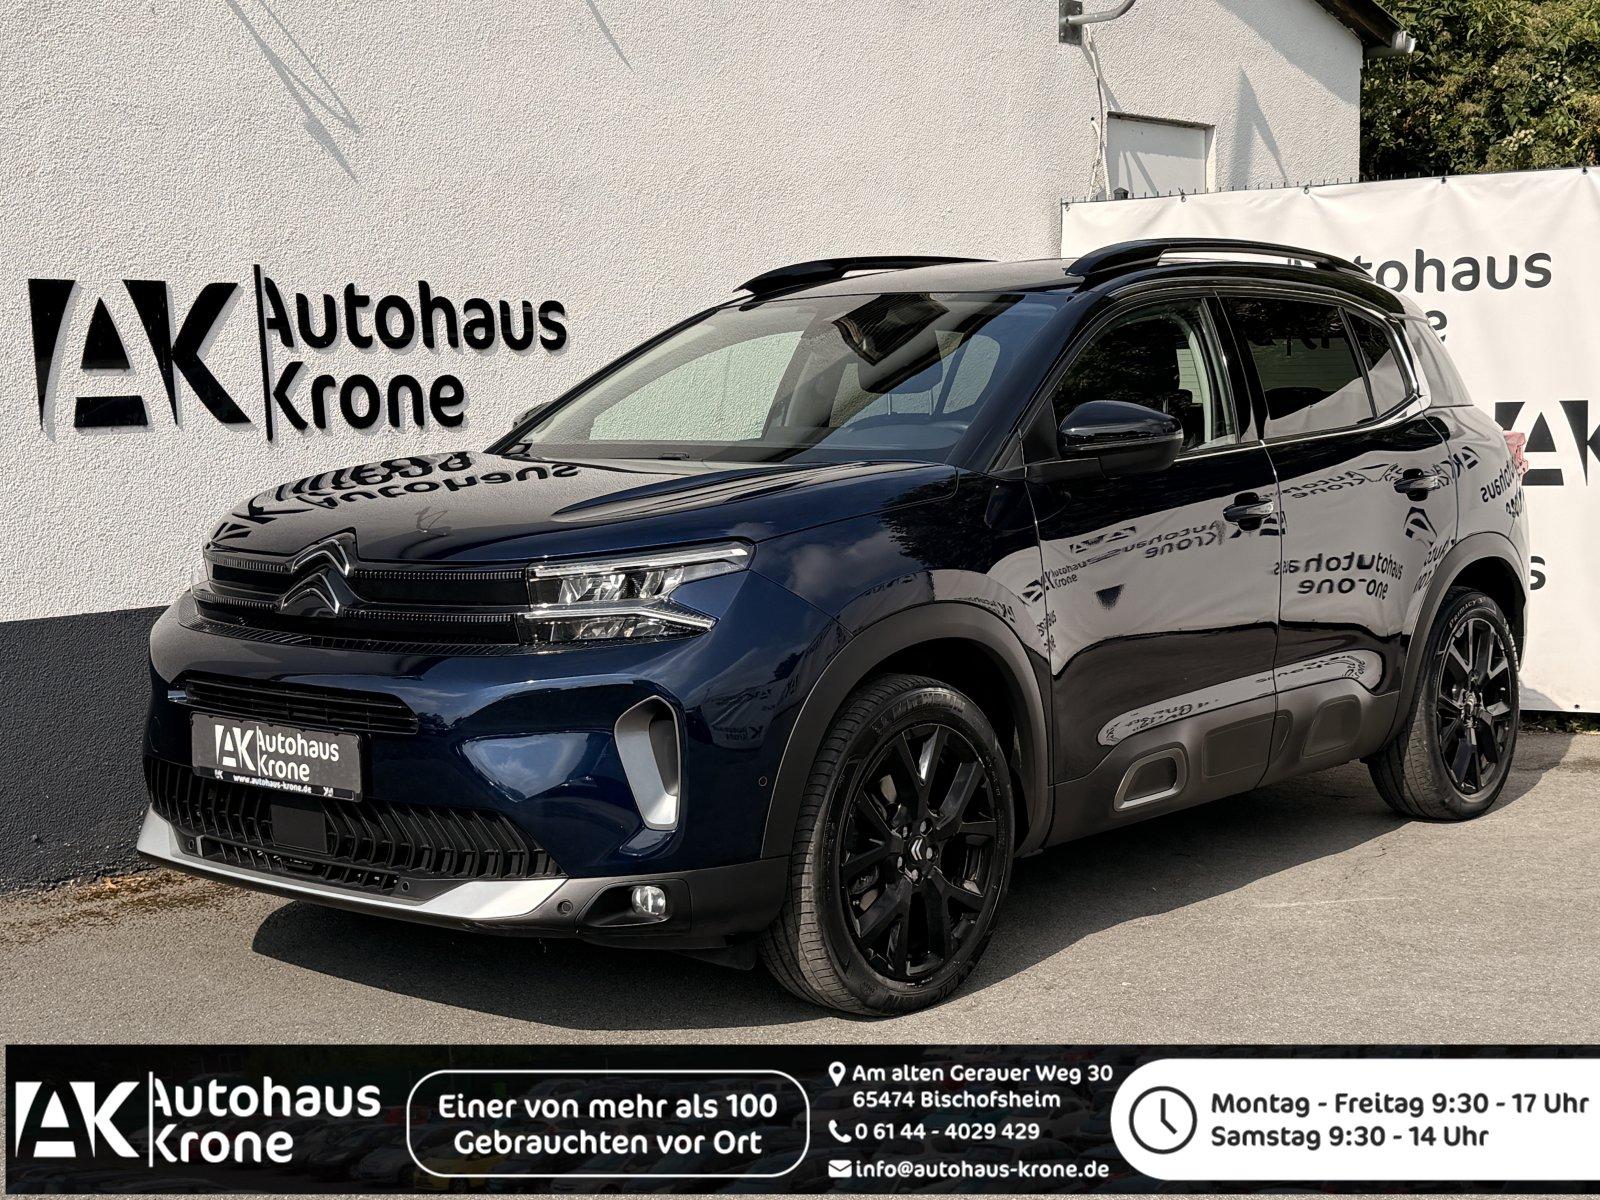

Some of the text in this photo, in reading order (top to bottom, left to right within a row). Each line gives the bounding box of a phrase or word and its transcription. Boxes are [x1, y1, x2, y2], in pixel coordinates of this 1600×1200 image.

[264, 276, 567, 351] Autohaus
[28, 278, 251, 431] AK
[273, 361, 465, 430] Krone
[215, 724, 256, 771] AK
[258, 729, 340, 762] Autohaus
[259, 754, 310, 782] Krone
[233, 774, 312, 794] www.autohaus-krone.de
